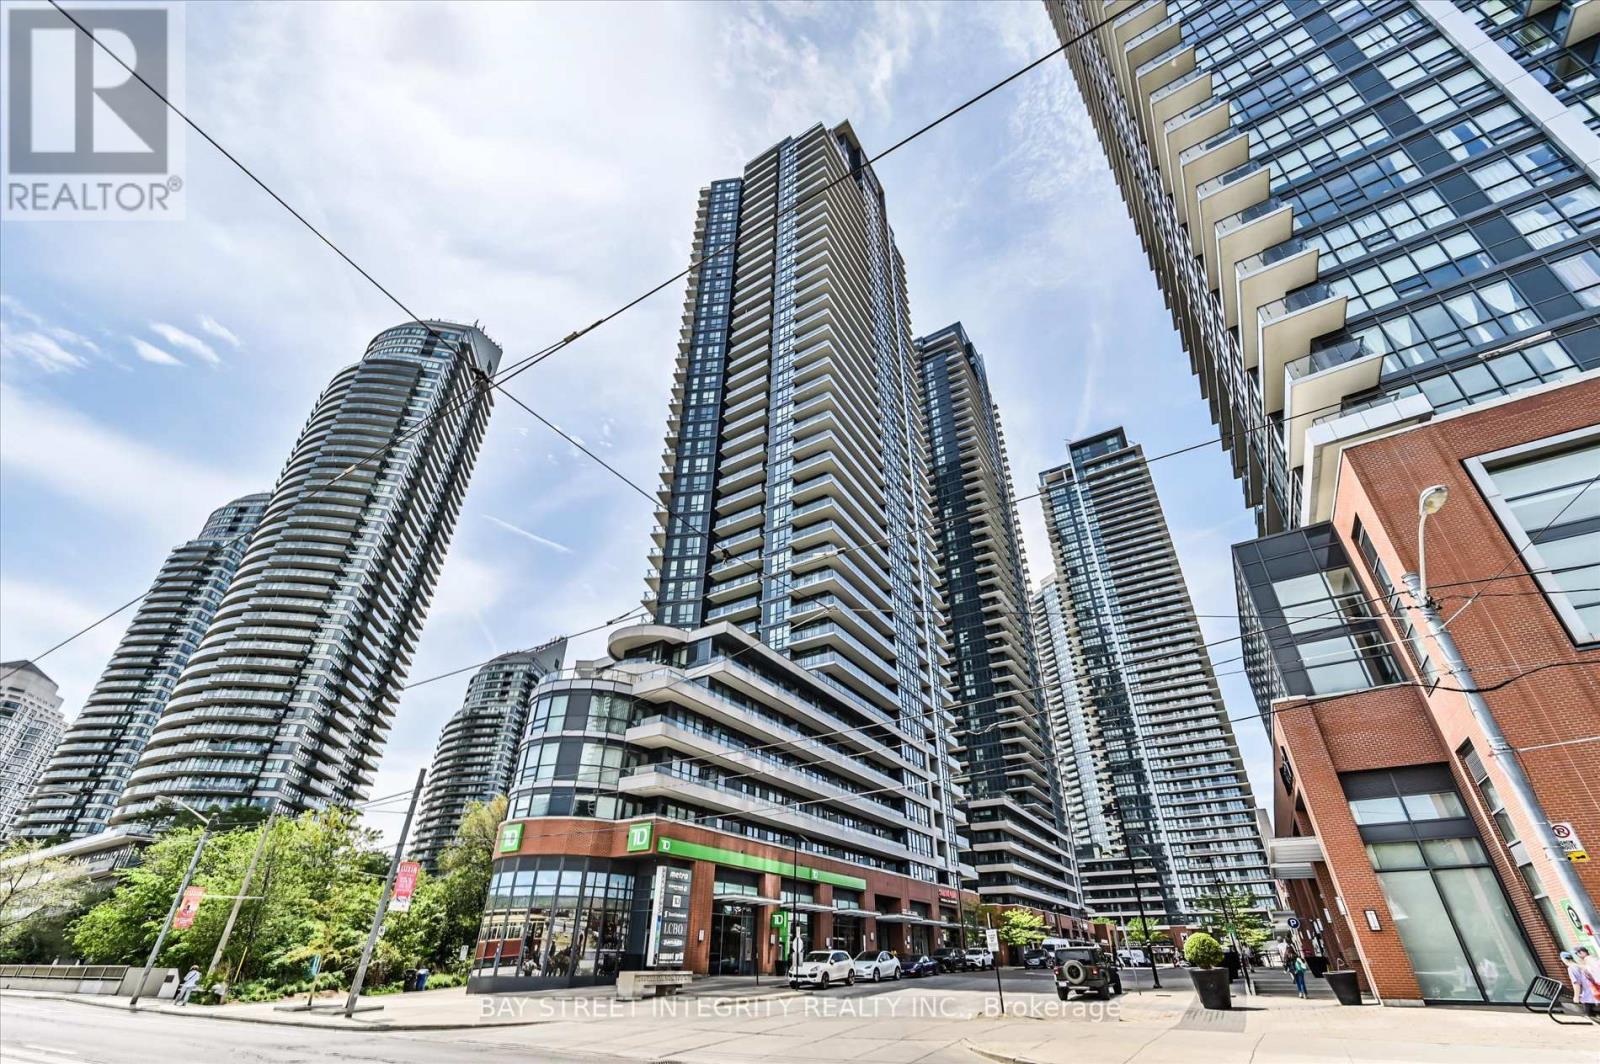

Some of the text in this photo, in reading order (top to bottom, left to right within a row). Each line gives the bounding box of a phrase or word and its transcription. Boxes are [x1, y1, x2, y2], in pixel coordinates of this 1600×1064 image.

[503, 829, 518, 847] TD
[632, 828, 648, 846] TD
[662, 839, 671, 850] TD
[669, 871, 689, 880] metro
[772, 914, 784, 925] TD
[664, 923, 683, 935] LCBO
